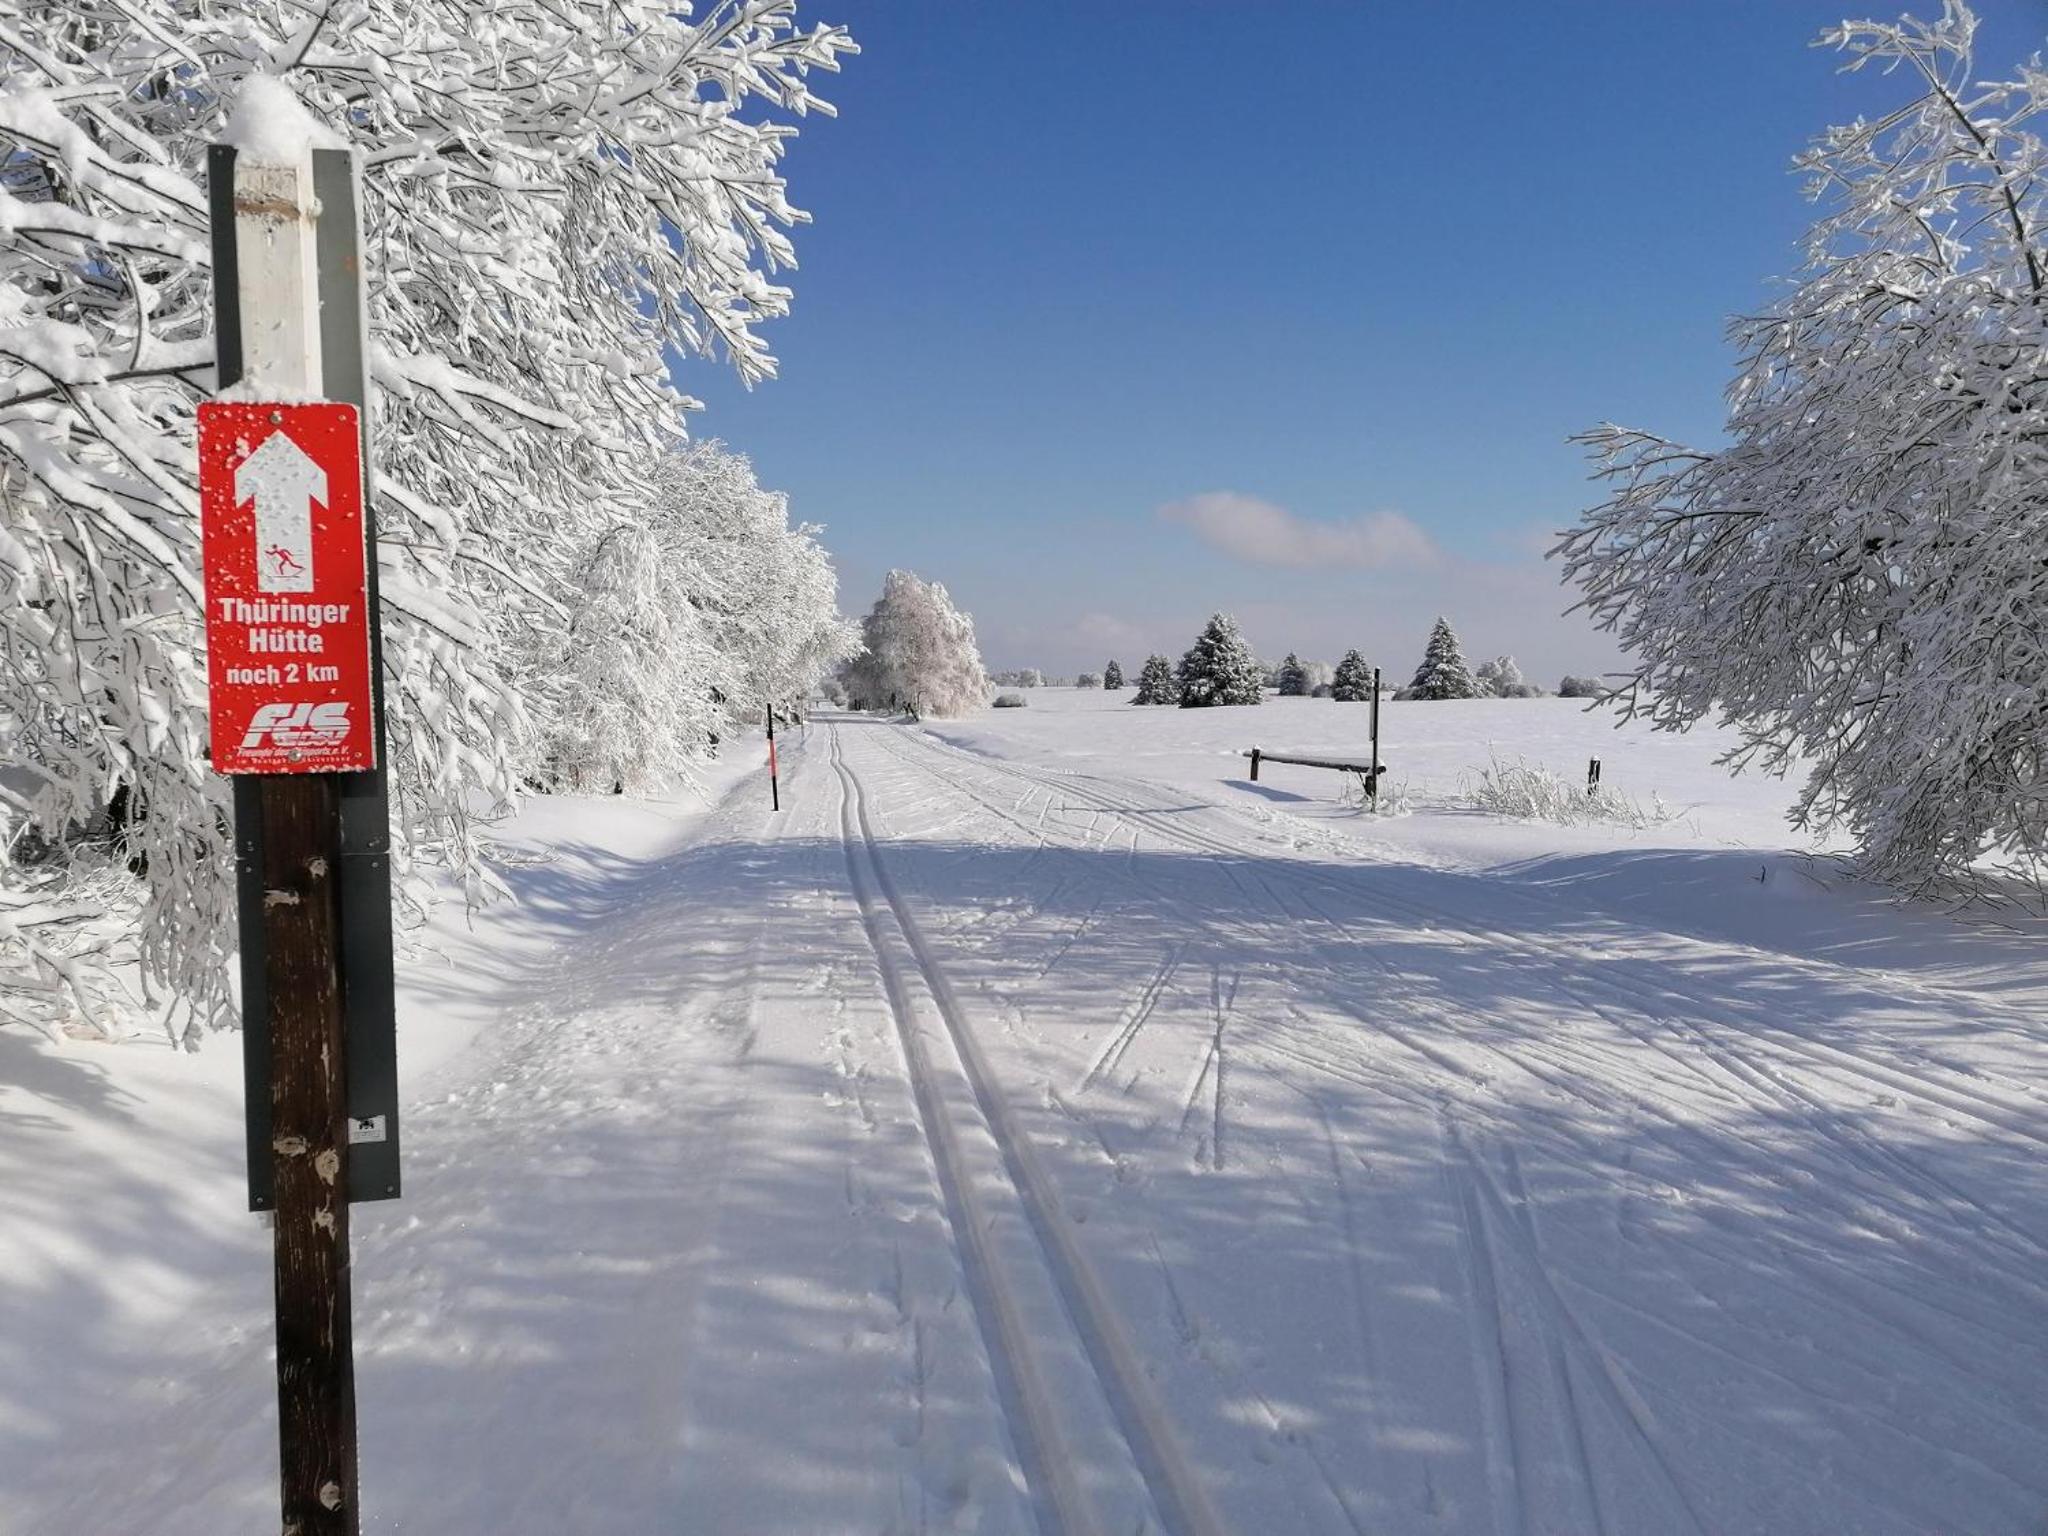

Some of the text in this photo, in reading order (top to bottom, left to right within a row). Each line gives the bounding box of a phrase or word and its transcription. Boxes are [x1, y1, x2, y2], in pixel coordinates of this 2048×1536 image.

[220, 598, 350, 627] Thüringer
[250, 627, 324, 653] Hütte
[226, 663, 339, 685] noch 2 km
